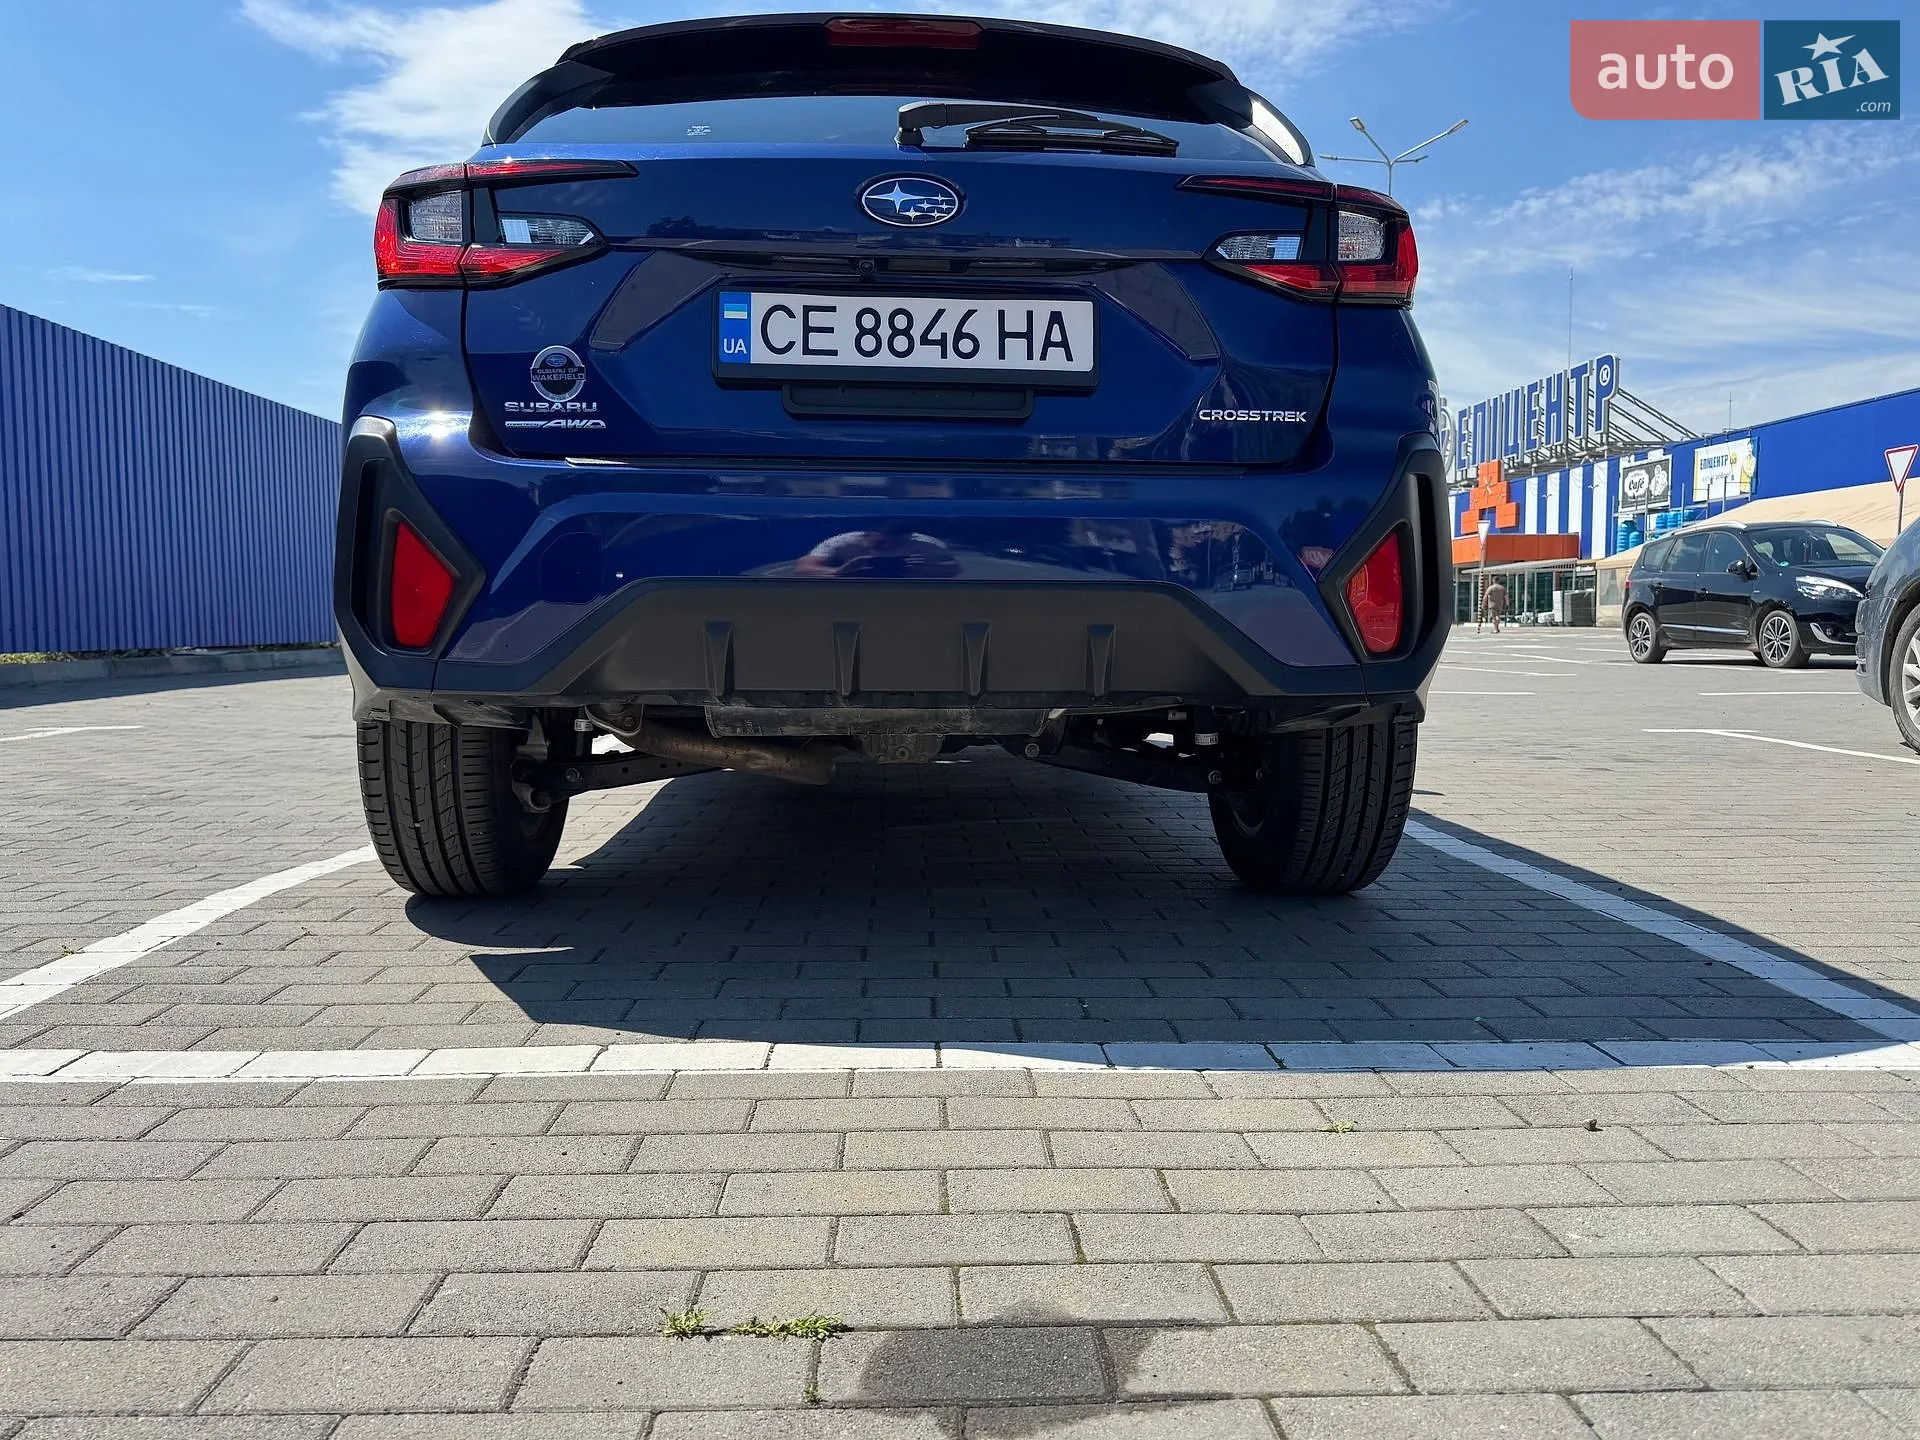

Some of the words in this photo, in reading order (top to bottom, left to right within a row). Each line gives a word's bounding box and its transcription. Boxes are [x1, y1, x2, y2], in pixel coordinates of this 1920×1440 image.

[760, 303, 839, 357] CE
[854, 307, 980, 359] 8846
[997, 309, 1074, 362] HA
[723, 338, 747, 354] UA
[532, 373, 585, 381] WAKEFIELD
[537, 367, 566, 375] SUBARU
[504, 401, 597, 413] SUBARU
[1199, 409, 1307, 422] CROSSTREK
[542, 419, 607, 429] AWD
